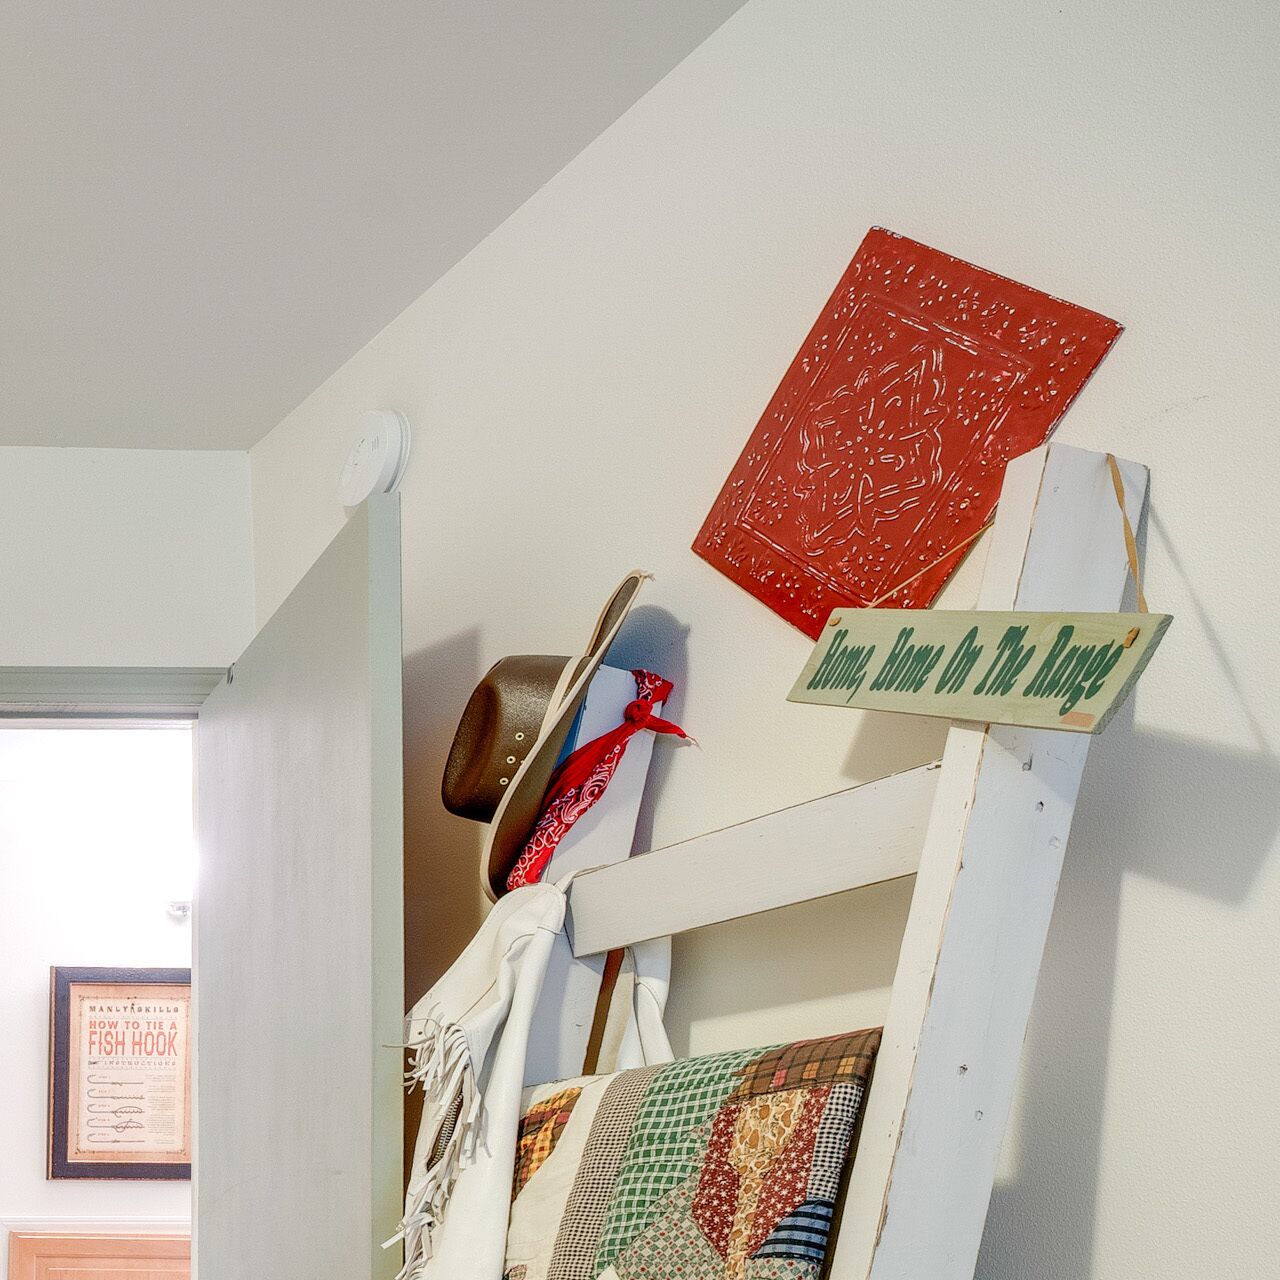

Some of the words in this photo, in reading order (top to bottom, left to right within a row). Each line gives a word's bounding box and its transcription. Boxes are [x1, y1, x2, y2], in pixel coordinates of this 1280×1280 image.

[869, 626, 946, 695] Home
[934, 624, 986, 695] On
[972, 623, 1037, 697] The
[1022, 624, 1129, 717] Range
[89, 1005, 128, 1013] MANLY
[89, 1020, 119, 1030] HOW
[124, 1020, 140, 1030] TO
[146, 1020, 164, 1030] TIE
[169, 1021, 177, 1030] A
[88, 1030, 126, 1056] FISH
[131, 1030, 178, 1057] HOOK
